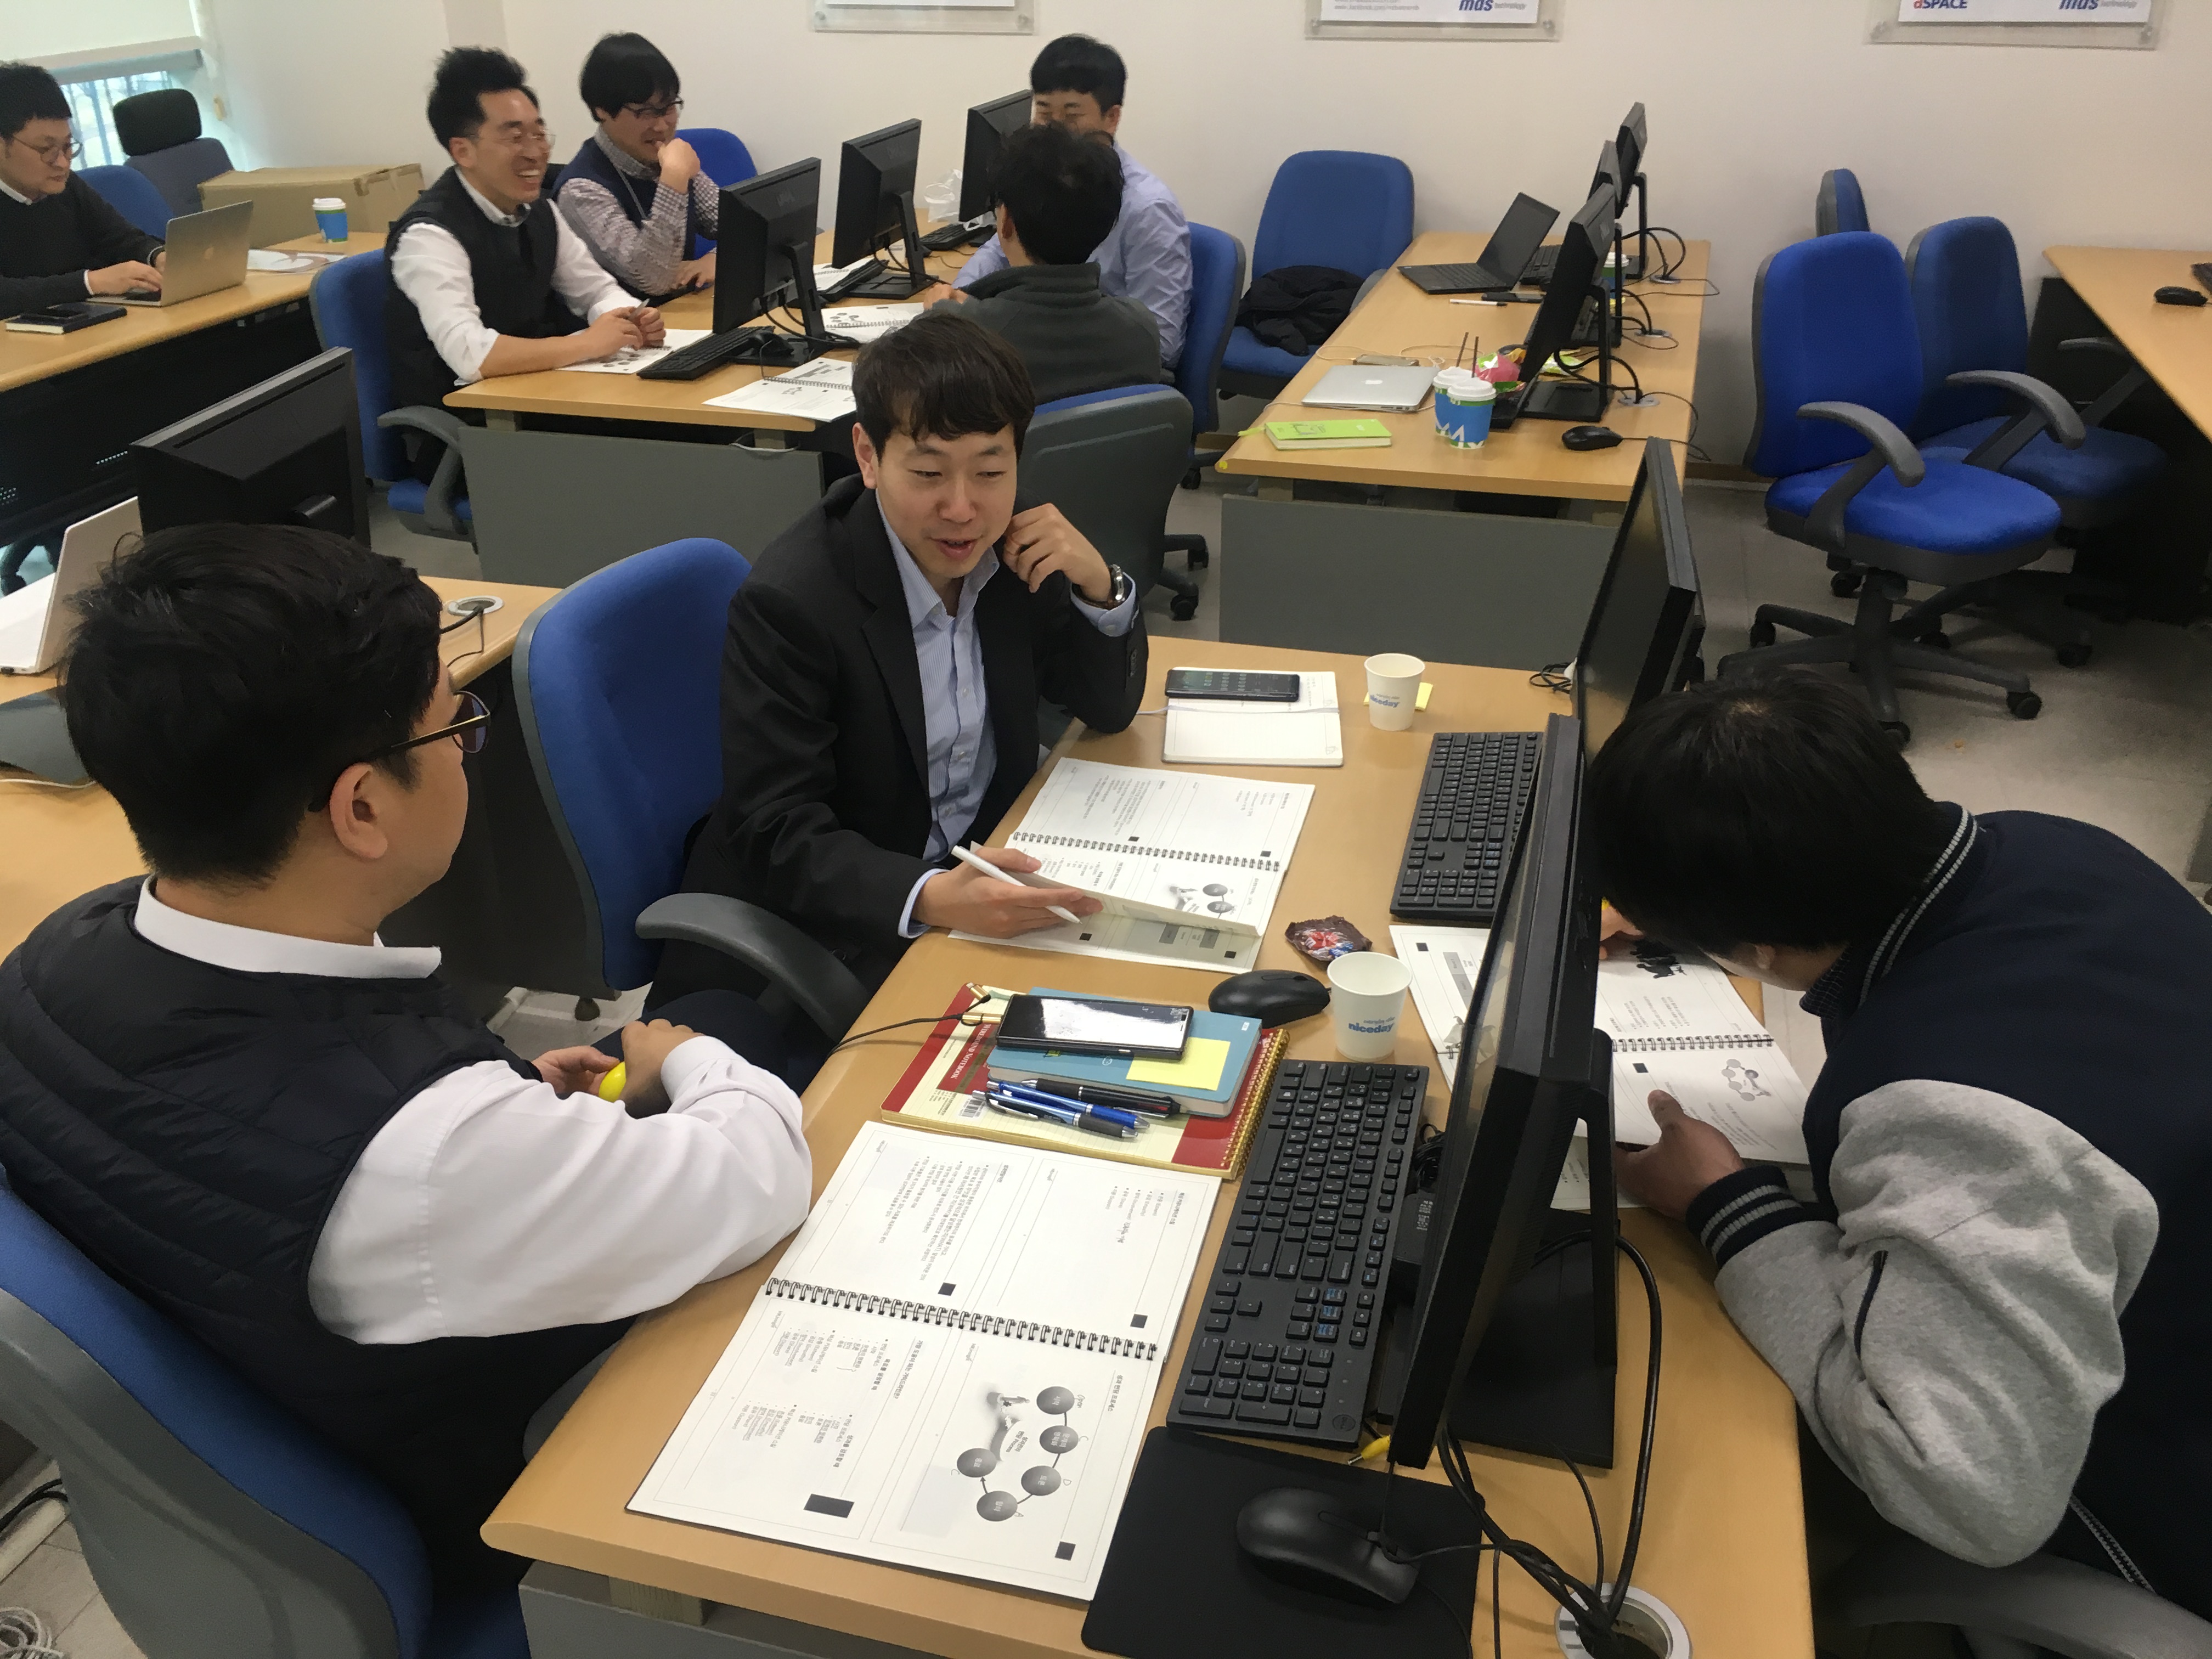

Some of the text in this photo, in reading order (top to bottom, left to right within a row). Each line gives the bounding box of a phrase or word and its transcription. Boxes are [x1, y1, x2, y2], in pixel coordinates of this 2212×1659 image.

[1348, 1023, 1395, 1033] niceday
[950, 1052, 974, 1080] NOTEBOOK
[880, 1359, 890, 1371] 목표를
[893, 1340, 923, 1398] 가장 도움이 되는 가이드라인은?
[873, 1373, 883, 1385] 설정할
[1108, 1375, 1122, 1411] 성과 면담 프로세스
[1052, 1396, 1062, 1405] 시작
[843, 1435, 853, 1447] 성과를
[836, 1449, 847, 1462] 검토할
